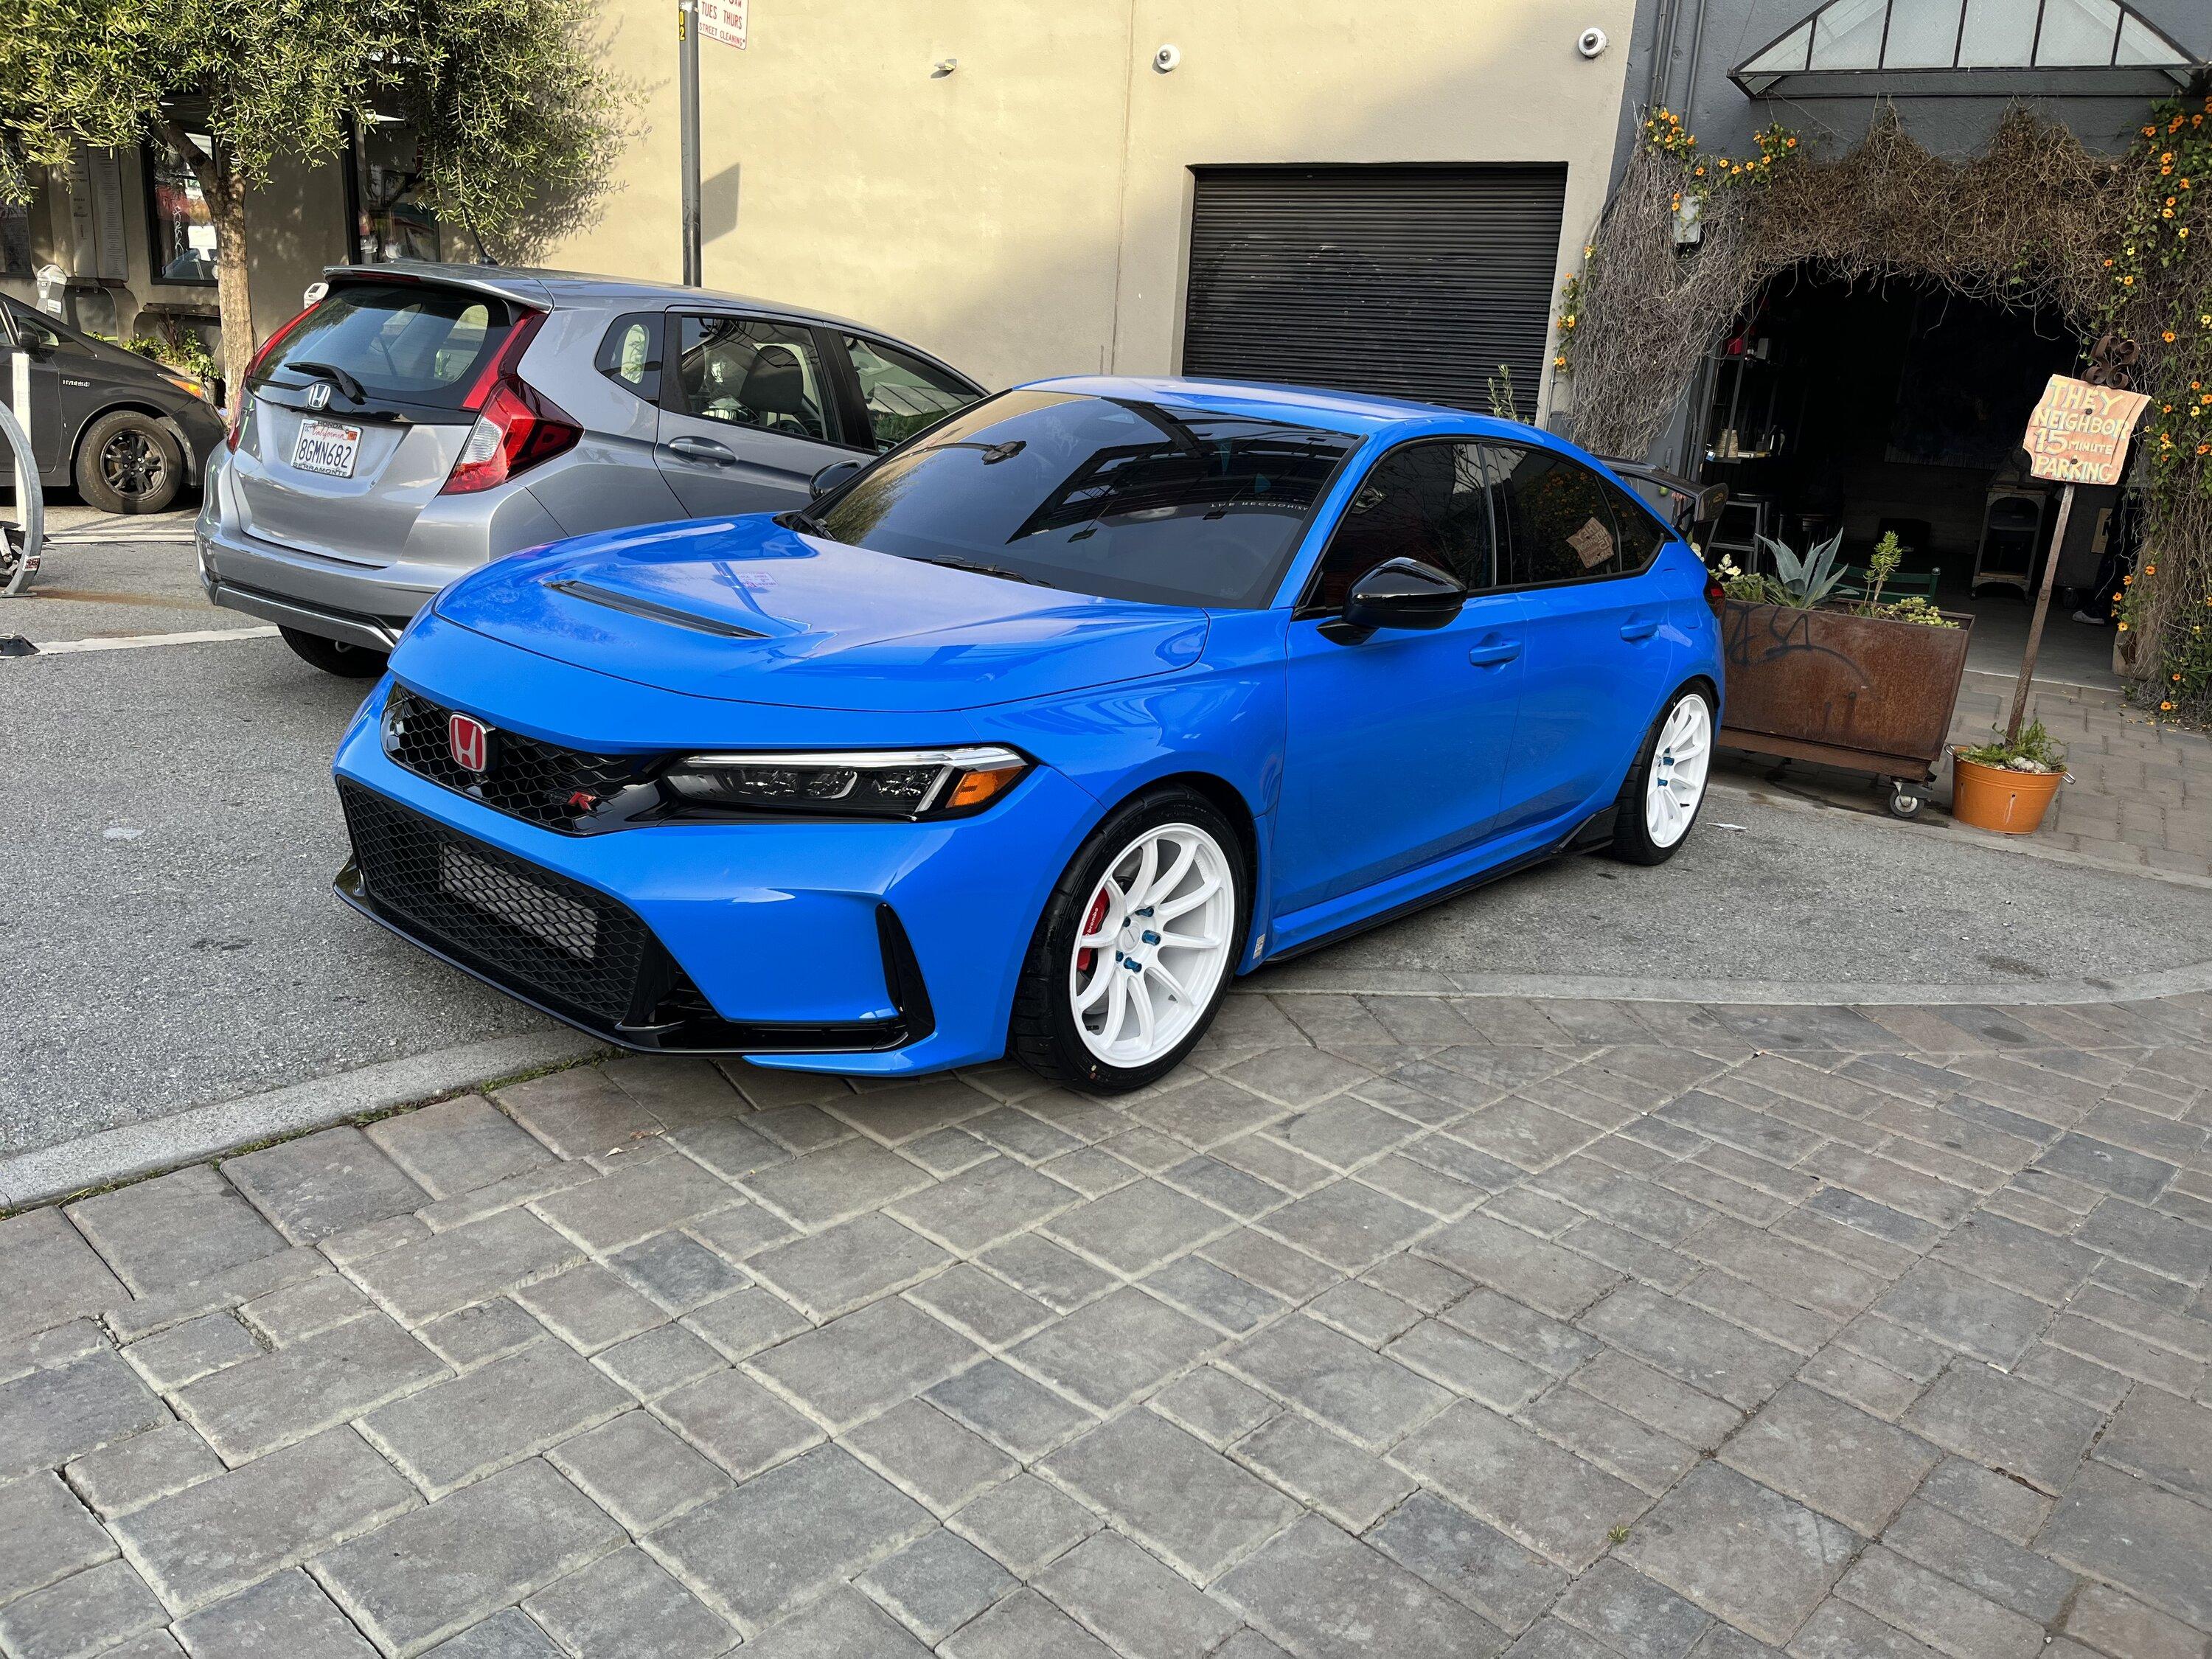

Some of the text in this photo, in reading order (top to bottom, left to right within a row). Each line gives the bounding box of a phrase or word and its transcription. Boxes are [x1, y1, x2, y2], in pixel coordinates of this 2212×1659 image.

[701, 1, 742, 29] TUES THURS
[699, 22, 742, 46] STREET CLEANING
[2048, 380, 2124, 416] THEY
[312, 426, 347, 441] California
[317, 420, 344, 430] HONDA
[2031, 407, 2130, 439] NEIGHBOR
[299, 438, 352, 468] 8GMN682
[2033, 428, 2114, 456] 15 MINUTE
[292, 462, 348, 476] SERRAMONTE
[2034, 454, 2113, 483] PARKING
[1086, 907, 1099, 933] brembo
